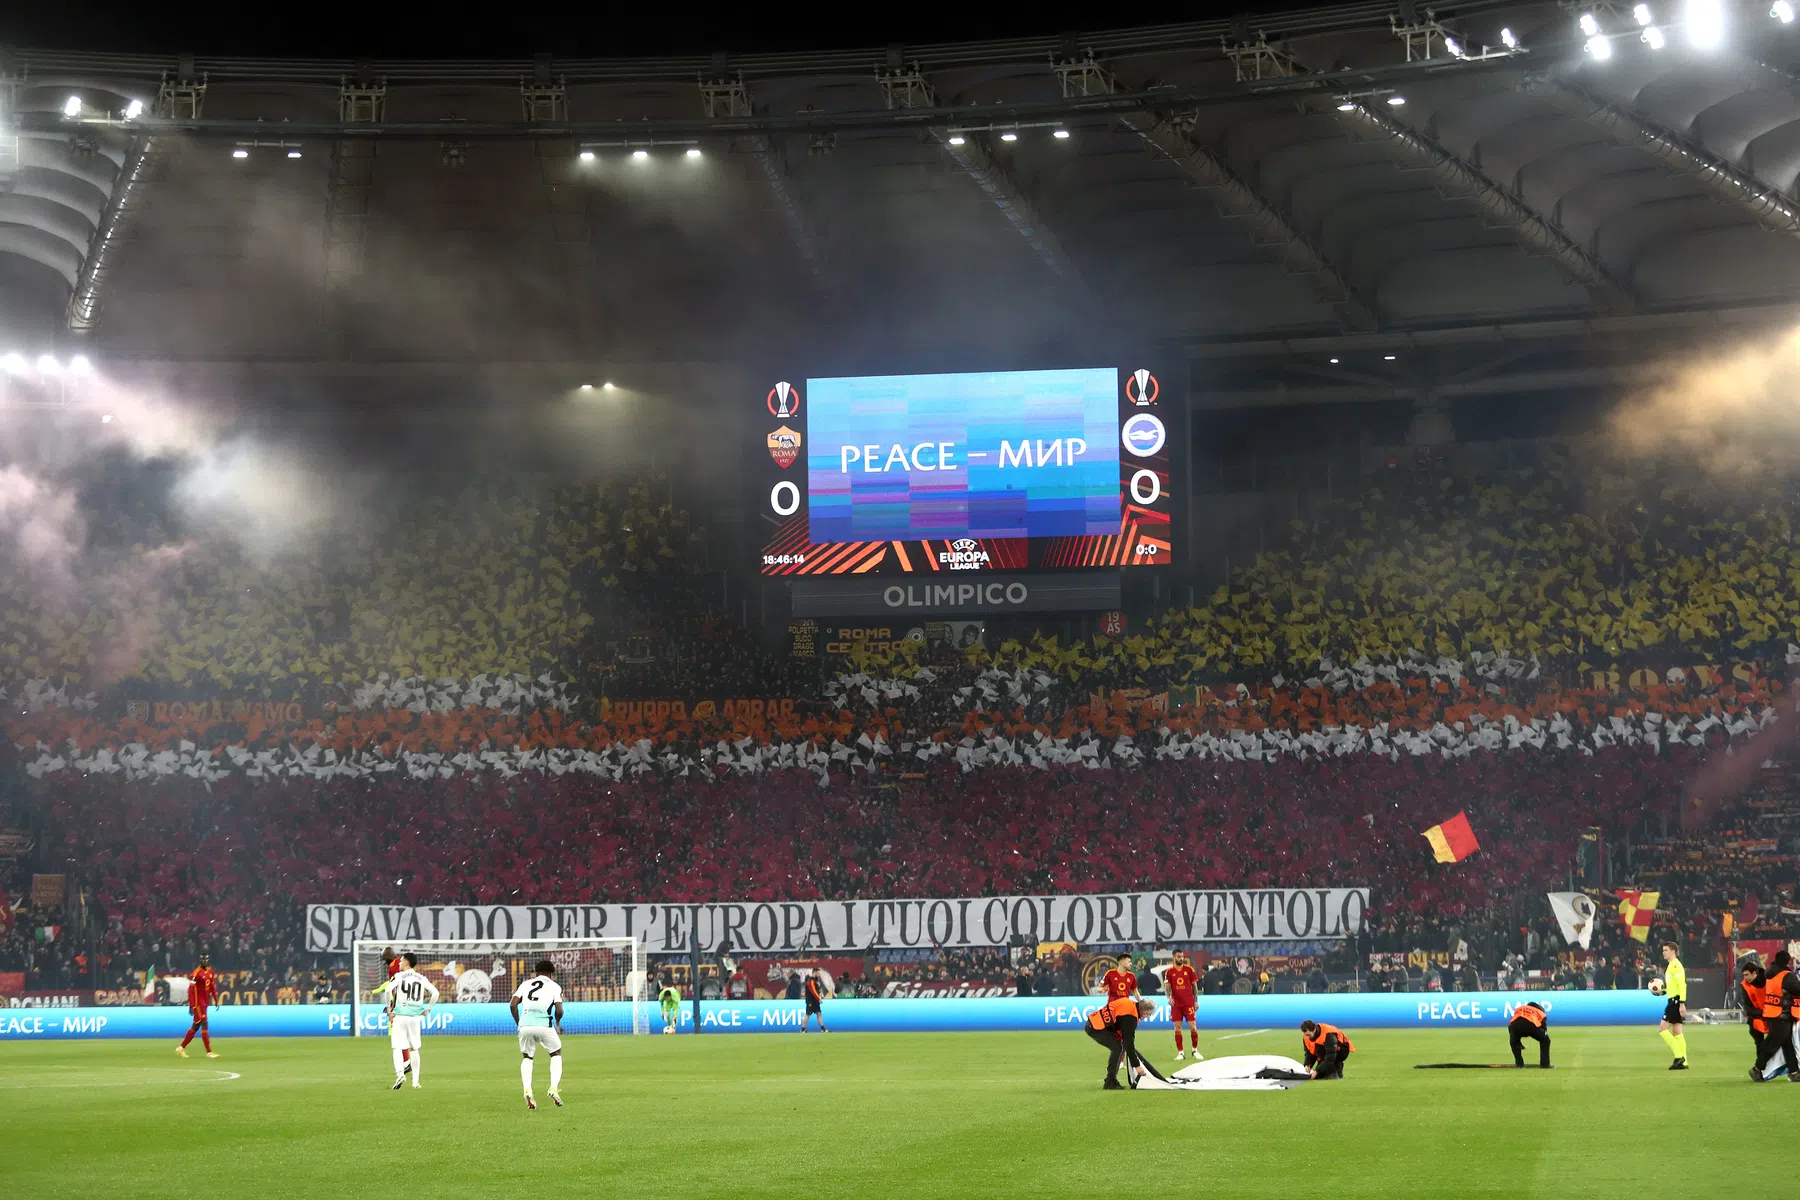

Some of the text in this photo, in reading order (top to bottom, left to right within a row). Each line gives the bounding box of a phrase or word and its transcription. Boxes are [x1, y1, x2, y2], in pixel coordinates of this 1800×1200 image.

[772, 450, 796, 458] ROMA
[840, 442, 957, 473] PEACE
[998, 438, 1087, 468] МИР
[1130, 469, 1161, 505] 0
[770, 480, 801, 516] 0
[953, 540, 976, 550] UEFA
[1135, 544, 1157, 555] 0:0
[762, 555, 805, 565] 18:46:14
[939, 550, 990, 563] EUROPA
[949, 562, 980, 570] LEAGUE
[883, 582, 1028, 608] OLIMPICO
[1106, 611, 1120, 622] 19
[838, 628, 892, 639] ROMA
[1106, 623, 1121, 634] AS
[826, 640, 906, 654] CETRO
[308, 889, 1368, 951] SPAVALDO PER L'EUROPA I TUOI COLORI SVENTOLO
[400, 979, 422, 1002] 40
[527, 980, 544, 1001] 2
[1417, 1002, 1482, 1019] PEACE
[1503, 1001, 1552, 1019] МР
[0, 1016, 44, 1033] EACE
[63, 1016, 107, 1033] МИР
[681, 1010, 742, 1026] PACE
